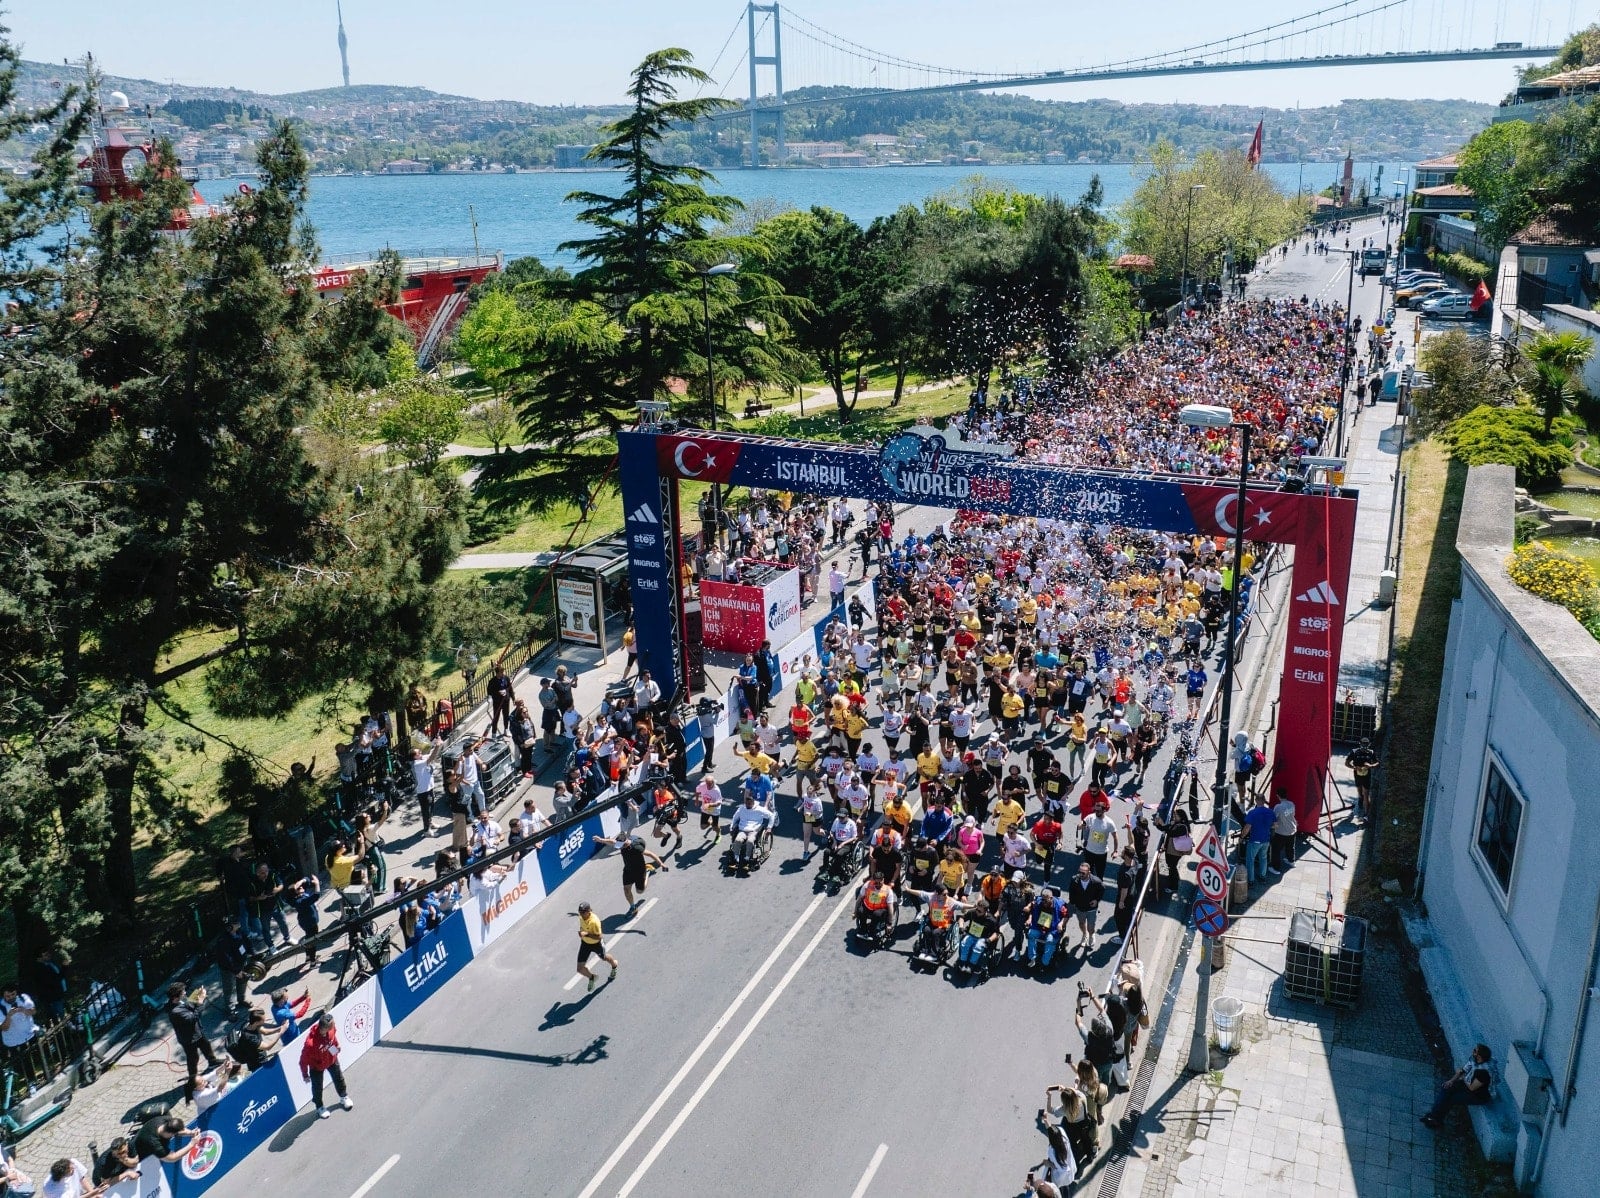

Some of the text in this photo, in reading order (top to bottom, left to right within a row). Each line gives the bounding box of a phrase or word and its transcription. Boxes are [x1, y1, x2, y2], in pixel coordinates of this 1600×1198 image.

[313, 274, 353, 288] SAFETY
[777, 456, 849, 486] İSTANBUL
[901, 471, 970, 499] WORLD
[1077, 490, 1120, 514] 2025
[637, 578, 659, 589] Erikli
[703, 595, 761, 613] KOŞAMAYANLAR
[1294, 669, 1324, 682] Erikli
[559, 829, 585, 859] step
[1202, 869, 1221, 892] 30
[404, 940, 447, 988] Erikli
